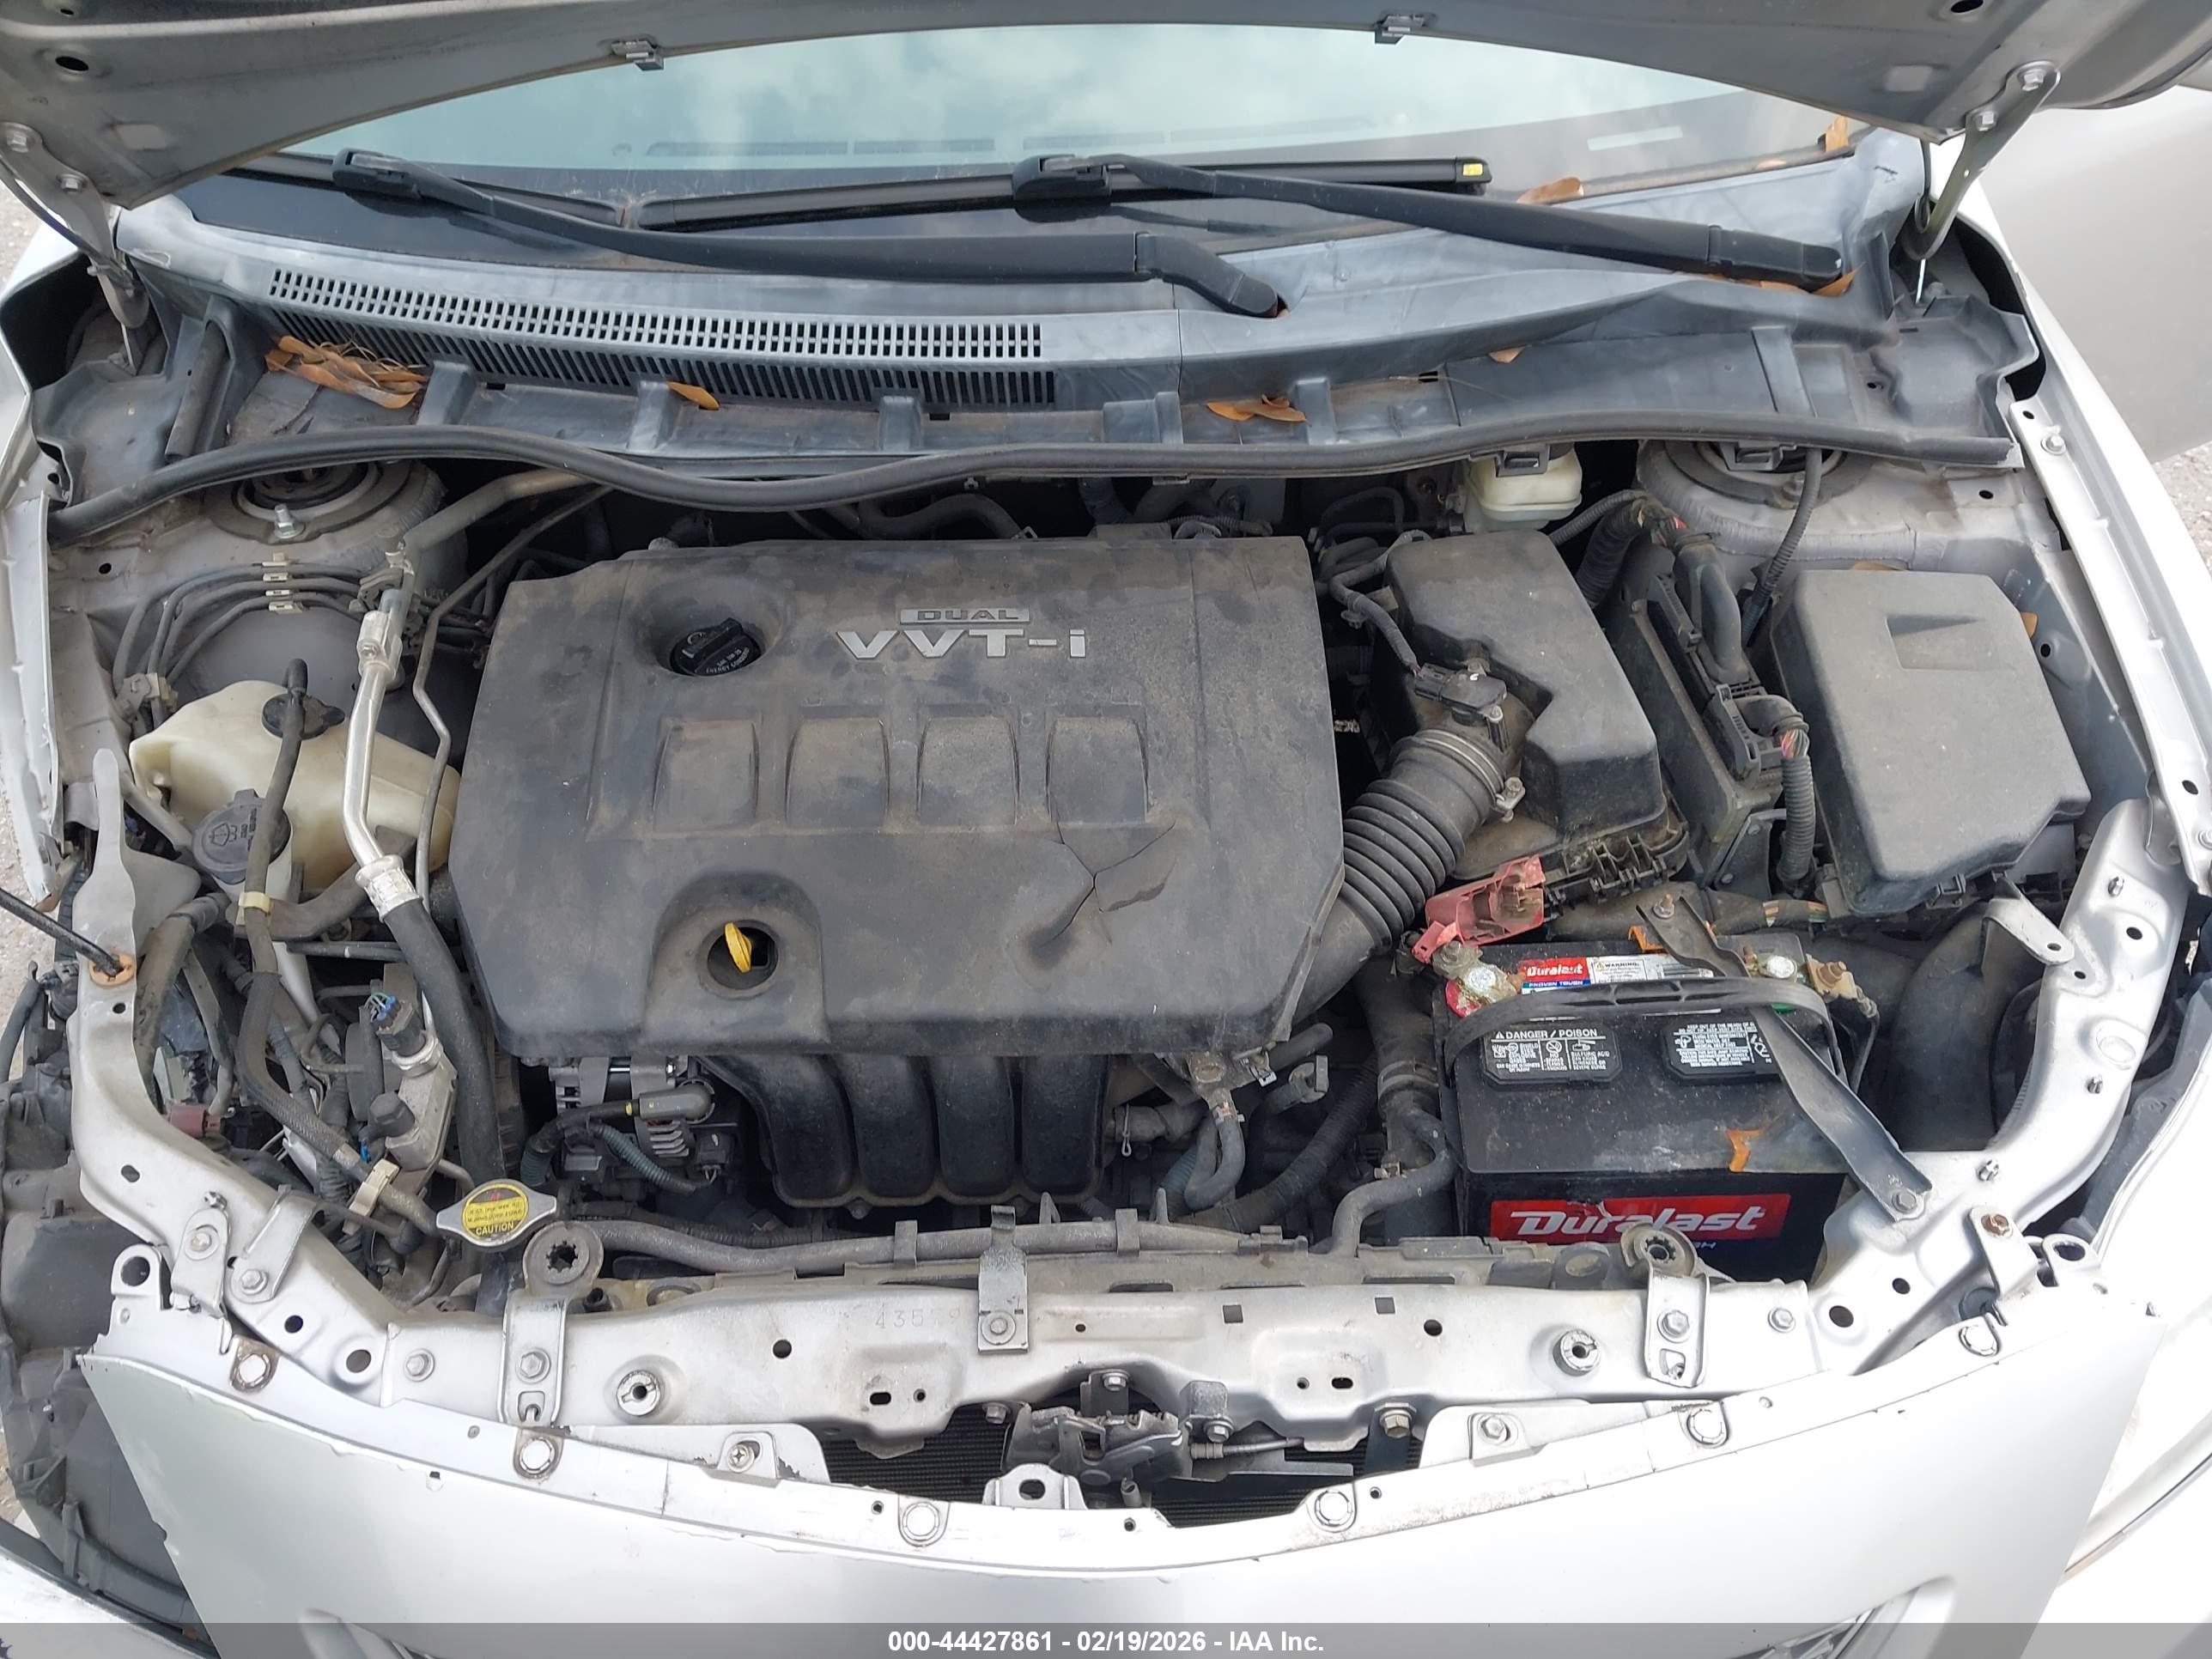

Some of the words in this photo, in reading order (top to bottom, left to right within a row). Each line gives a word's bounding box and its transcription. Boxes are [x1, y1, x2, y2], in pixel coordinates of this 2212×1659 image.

[917, 610, 1019, 621] DUAL
[836, 629, 1086, 659] VVT-i
[1505, 1030, 1548, 1039] DANGER
[1559, 1029, 1598, 1038] POISON
[476, 1220, 514, 1235] CAUTION
[1510, 1206, 1765, 1236] Duralast
